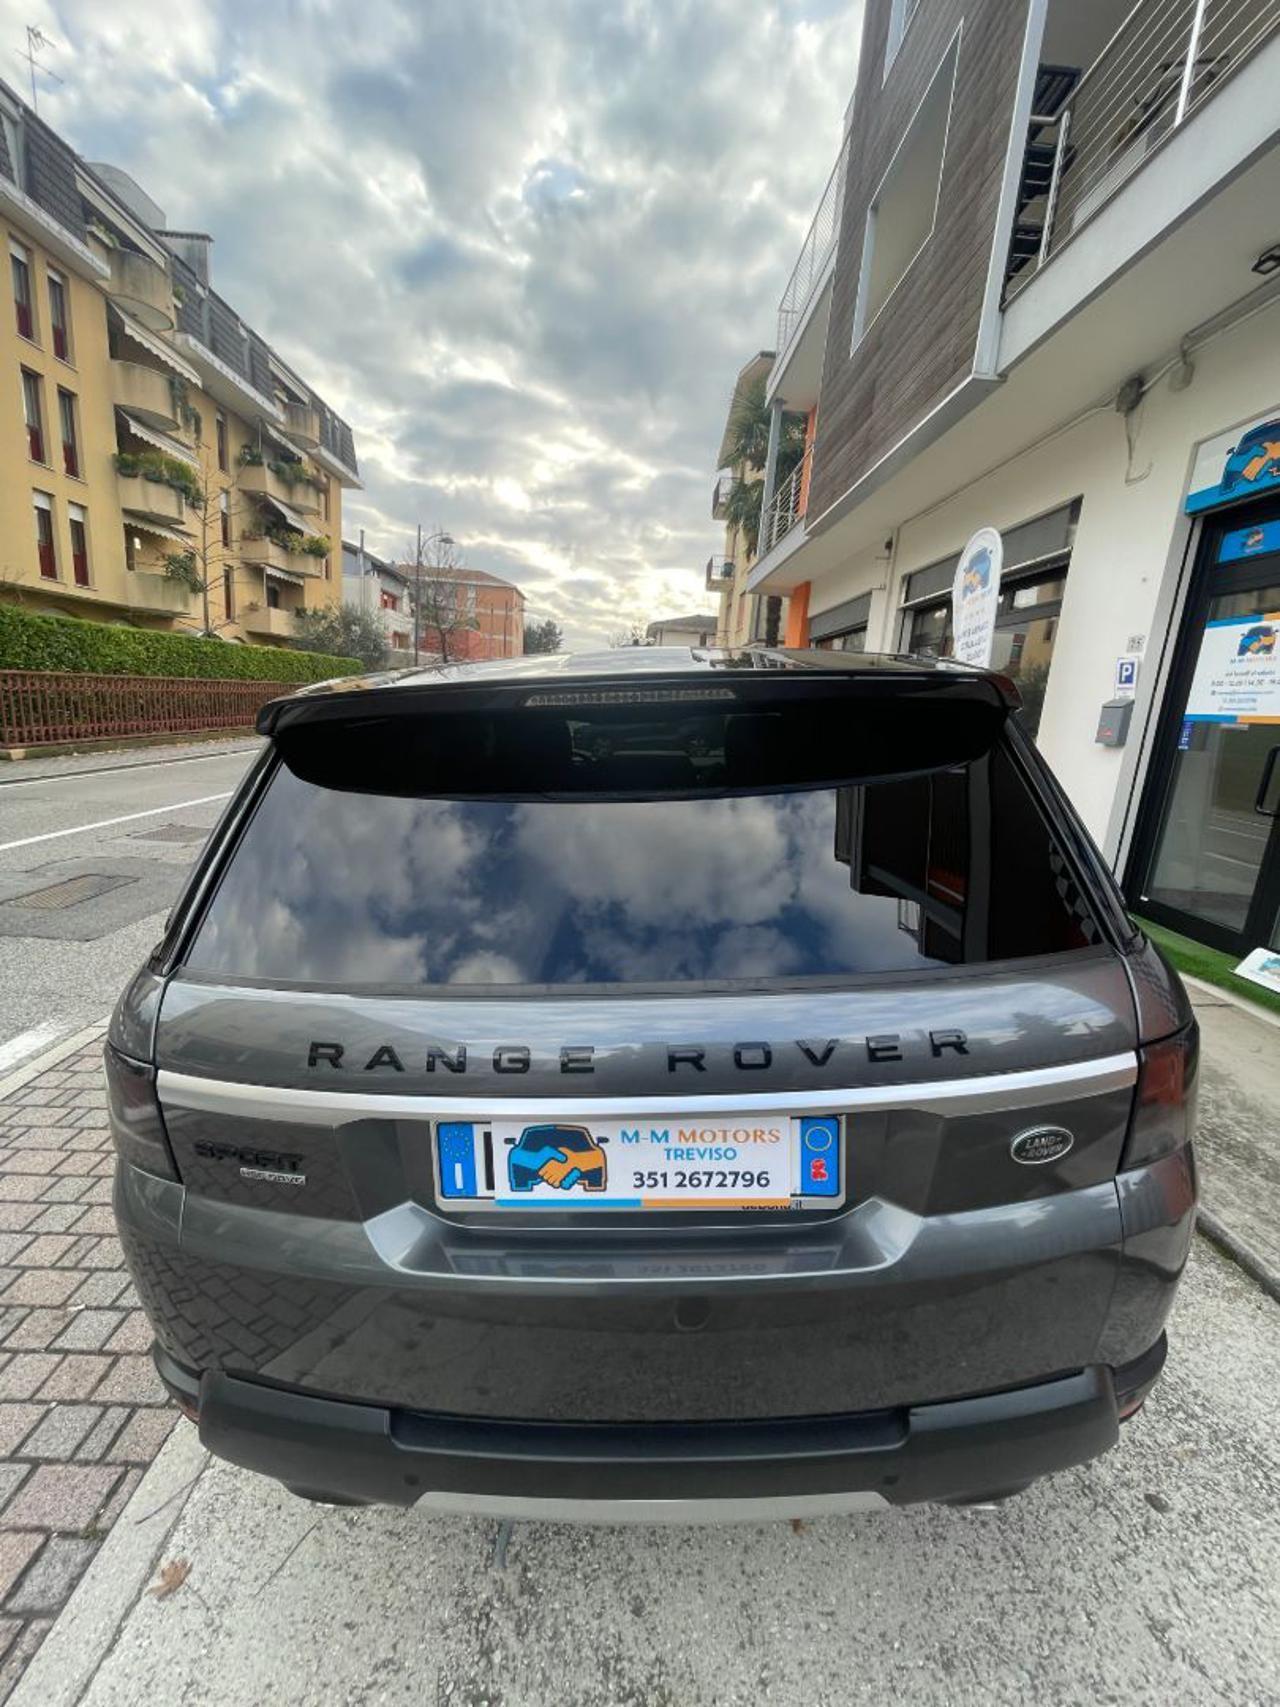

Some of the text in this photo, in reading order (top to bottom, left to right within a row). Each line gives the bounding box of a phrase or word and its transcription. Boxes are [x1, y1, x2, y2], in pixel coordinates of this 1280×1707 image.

[1121, 664, 1132, 682] P
[307, 1028, 970, 1074] RANGE ROVER
[620, 1128, 781, 1144] M-M MOTORS
[192, 1139, 304, 1172] SPORT
[664, 1147, 737, 1161] TREVISO
[633, 1170, 770, 1188] 351 2672796
